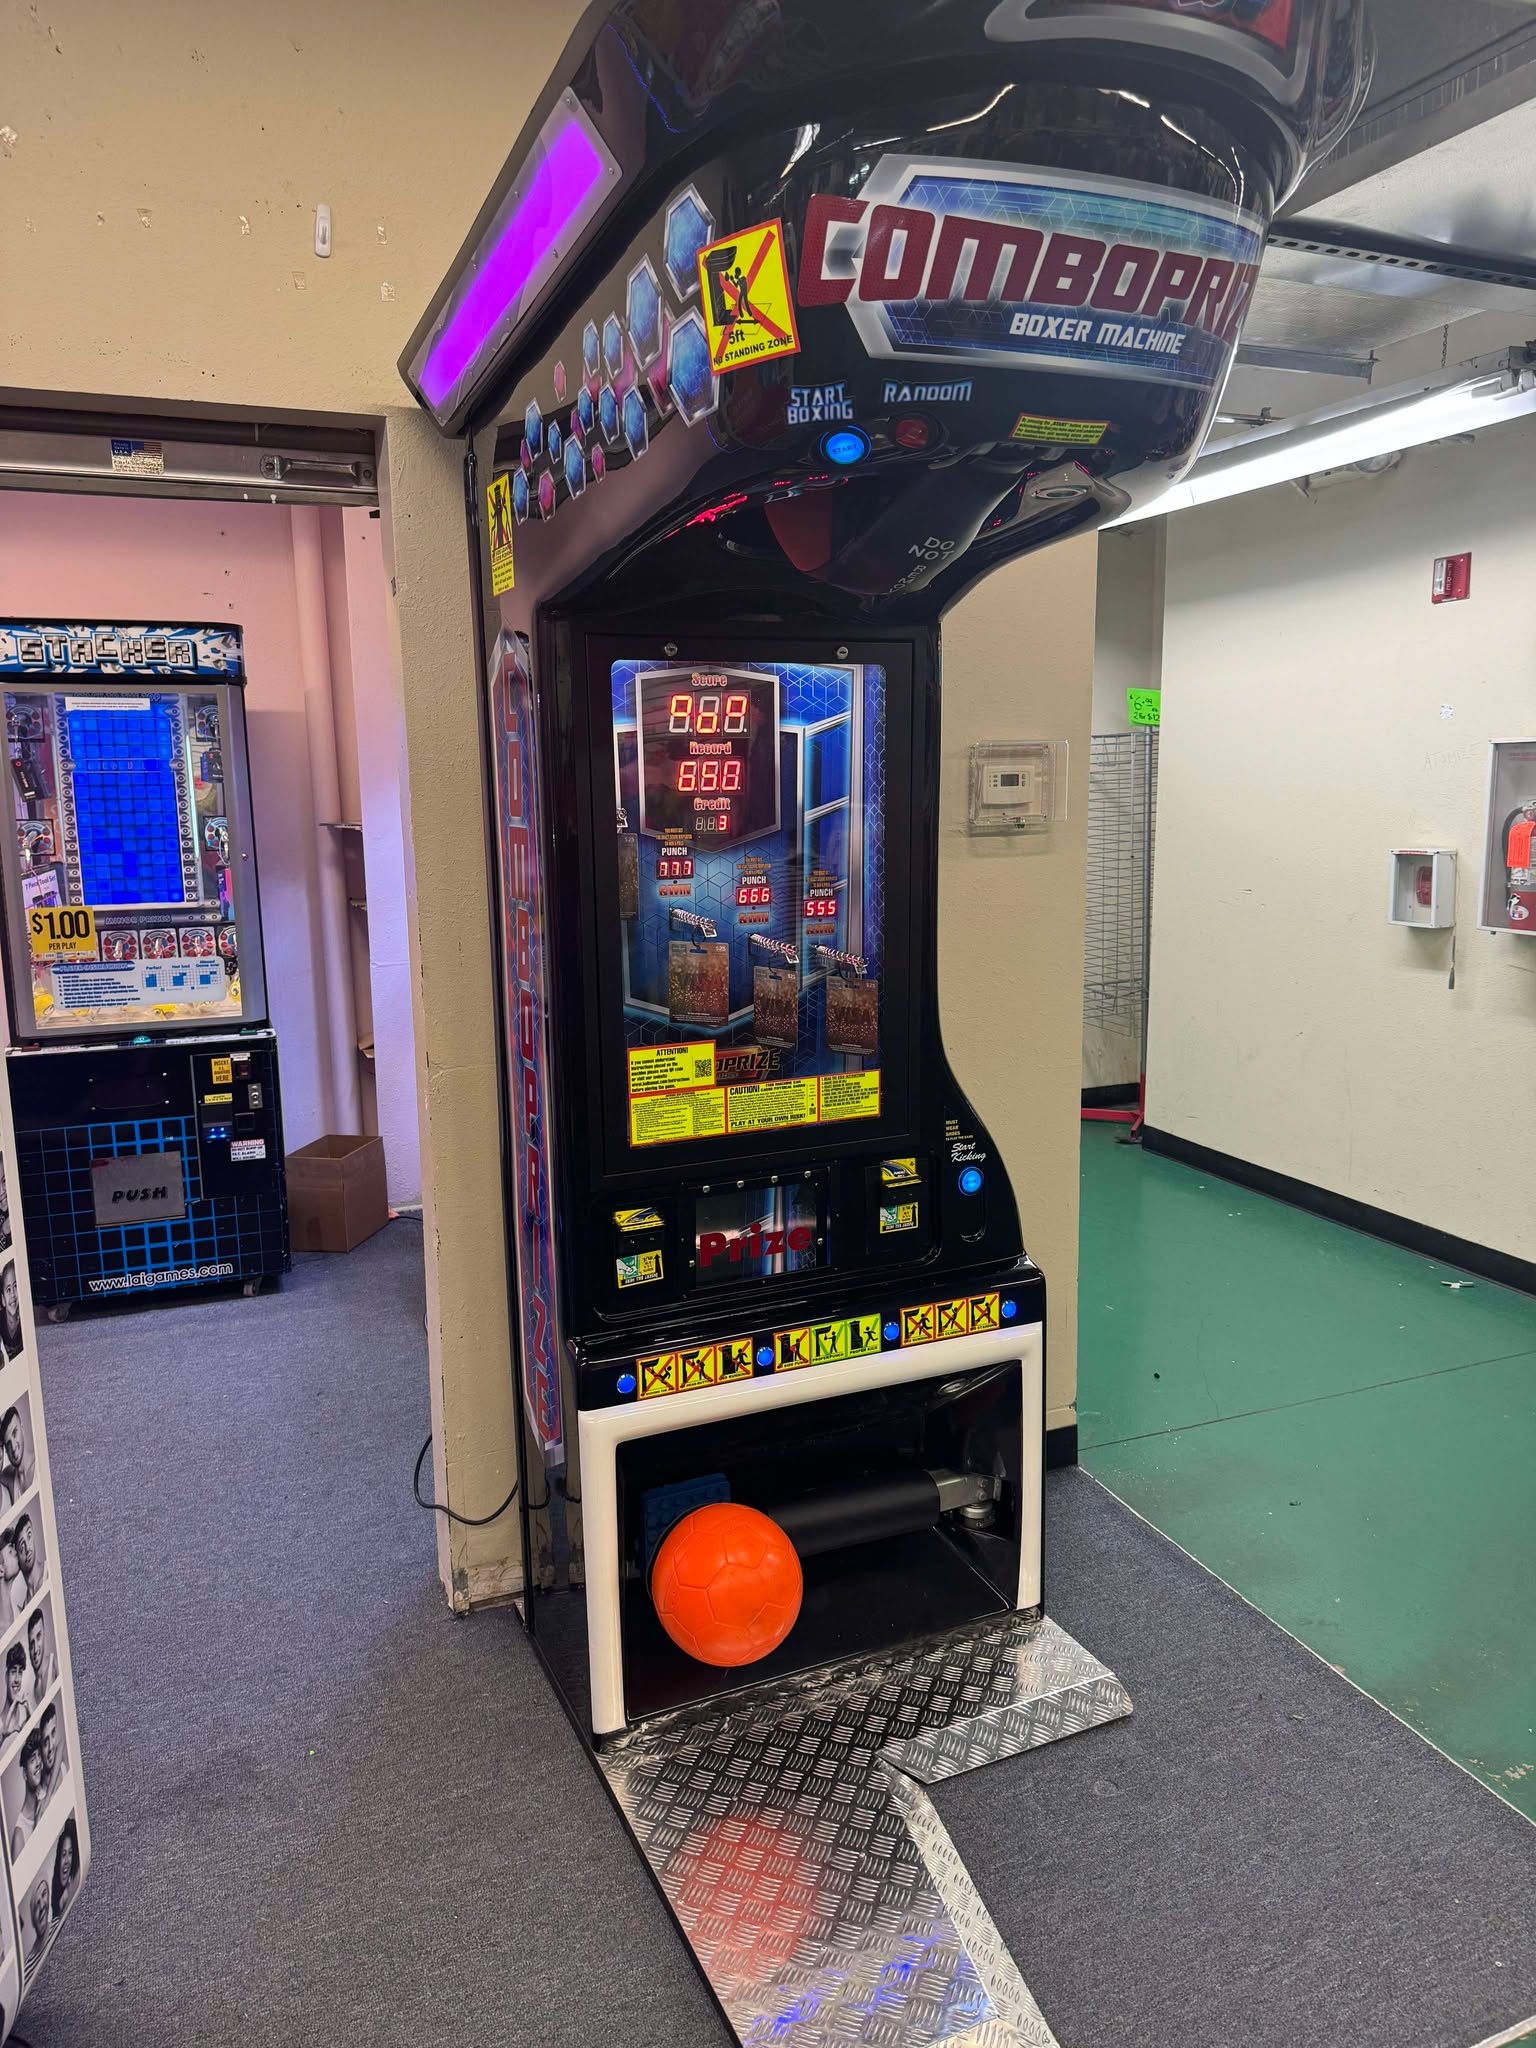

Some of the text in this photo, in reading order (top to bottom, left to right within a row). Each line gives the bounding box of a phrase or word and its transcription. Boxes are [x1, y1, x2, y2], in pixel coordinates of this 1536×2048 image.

[728, 329, 745, 344] 5ft
[1009, 313, 1186, 354] BOXER MACHINE
[714, 334, 793, 366] NO STANDING ZONE
[791, 383, 845, 407] START
[787, 400, 853, 425] BOXING
[832, 444, 857, 454] START
[924, 537, 954, 550] DO
[908, 544, 954, 560] NOT
[19, 633, 193, 664] STACKER
[692, 672, 727, 686] Score
[690, 741, 732, 754] Record
[694, 797, 730, 811] Credit
[662, 847, 687, 856] PUNCH
[660, 861, 691, 876] 777
[742, 876, 766, 884] PUNCH
[740, 888, 769, 903] 666
[810, 888, 833, 897] PUNCH
[807, 901, 835, 916] 555
[32, 910, 90, 940] $1.00
[106, 915, 172, 924] MINOR PRIZES
[656, 1047, 688, 1056] ATTENTION!
[730, 1085, 759, 1095] CAUTION!
[231, 1139, 264, 1147] WARNING
[951, 1142, 976, 1153] Start
[951, 1151, 986, 1162] Kicking
[112, 1186, 168, 1204] PUSH
[699, 1223, 812, 1268] Prize
[88, 1263, 233, 1292] www.laigames.com
